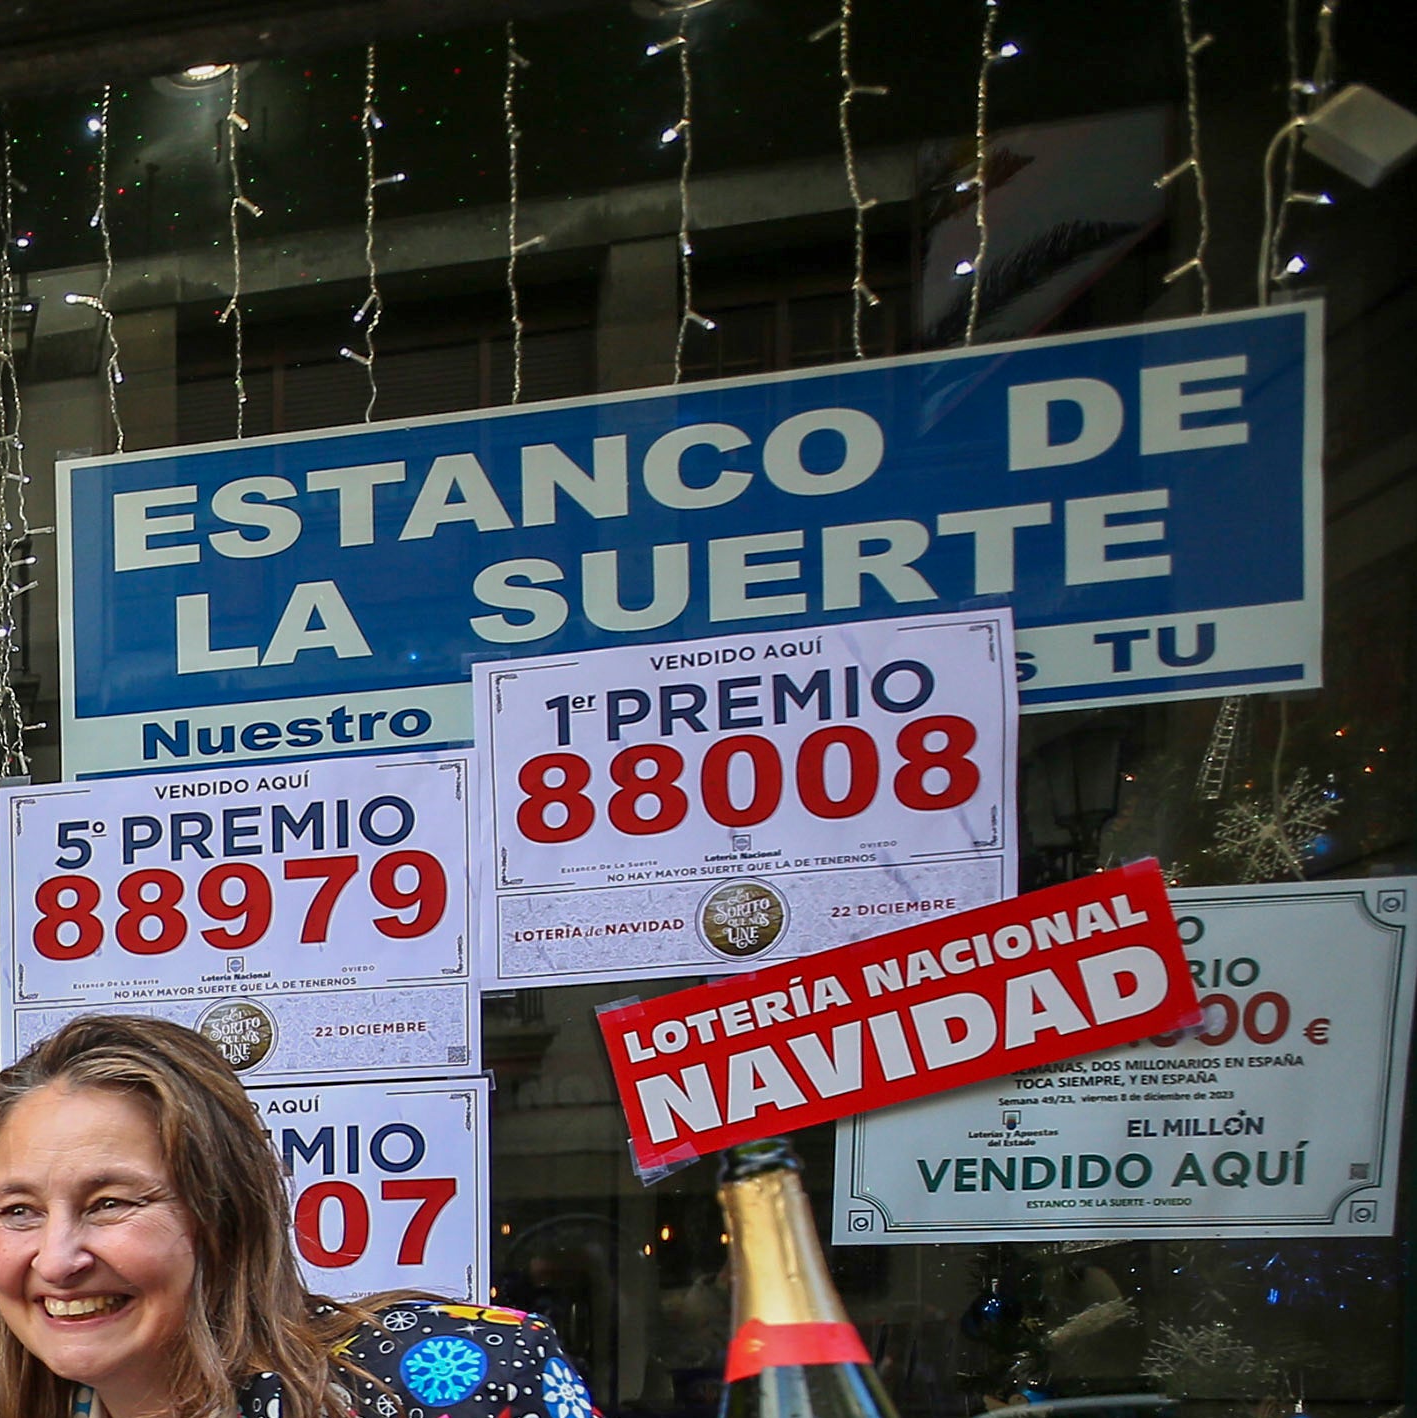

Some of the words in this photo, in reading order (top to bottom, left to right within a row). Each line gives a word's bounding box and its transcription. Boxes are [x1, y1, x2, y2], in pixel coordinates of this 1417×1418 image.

[113, 407, 885, 573] ESTANCO
[1007, 354, 1249, 472] DE
[176, 580, 373, 675] LA
[469, 488, 1172, 645] SUERTE
[650, 645, 757, 672] VENDIDO
[763, 635, 822, 661] AQUÍ
[1093, 622, 1218, 674] TU
[606, 658, 935, 742] PREMIO
[141, 704, 433, 762] Nuestro
[154, 778, 253, 802] VENDIDO
[256, 768, 312, 794] AQUÍ
[515, 714, 981, 845] 88008
[121, 794, 417, 866] PREMIO
[607, 874, 625, 883] NO
[628, 871, 652, 881] HAY
[654, 867, 698, 879] MAYOR
[700, 863, 745, 876] SUERTE
[747, 861, 773, 873] QUE
[775, 860, 792, 869] LA
[794, 858, 811, 868] DE
[813, 853, 878, 867] TENERNOS
[739, 849, 782, 860] Nacional
[32, 848, 448, 962] 88979
[831, 905, 853, 918] 22
[857, 897, 957, 917] DICIEMBRE
[514, 924, 583, 944] LOTERÍA
[604, 917, 686, 936] NAVIDAD
[114, 990, 130, 1000] NO
[132, 989, 155, 999] HAY
[157, 986, 195, 997] MAYOR
[197, 983, 238, 995] SUERTE
[240, 982, 263, 993] QUE
[265, 981, 280, 991] LA
[282, 980, 297, 989] DE
[298, 976, 357, 989] TENERNOS
[234, 971, 271, 980] Nacional
[622, 977, 853, 1064] LOTERÍA
[862, 893, 1148, 998] NACIONAL
[314, 1024, 334, 1038] 22
[339, 1020, 427, 1037] DICIEMBRE
[634, 944, 1170, 1144] NAVIDAD
[1092, 1058, 1121, 1073] DOS
[1125, 1056, 1221, 1072] MILLONARIOS
[1224, 1056, 1245, 1069] EN
[1248, 1052, 1304, 1067] ESPAÑA
[1015, 1076, 1054, 1090] TOCA
[1058, 1074, 1125, 1089] SIEMPRE,
[1128, 1074, 1137, 1085] Y
[1139, 1073, 1159, 1085] EN
[1162, 1070, 1219, 1085] ESPAÑA
[267, 1094, 321, 1115] AQUÍ
[1126, 1118, 1153, 1138] EL
[916, 1151, 1153, 1195] VENDIDO
[1171, 1139, 1311, 1190] AQUÍ
[1026, 1199, 1077, 1209] ESTANCO
